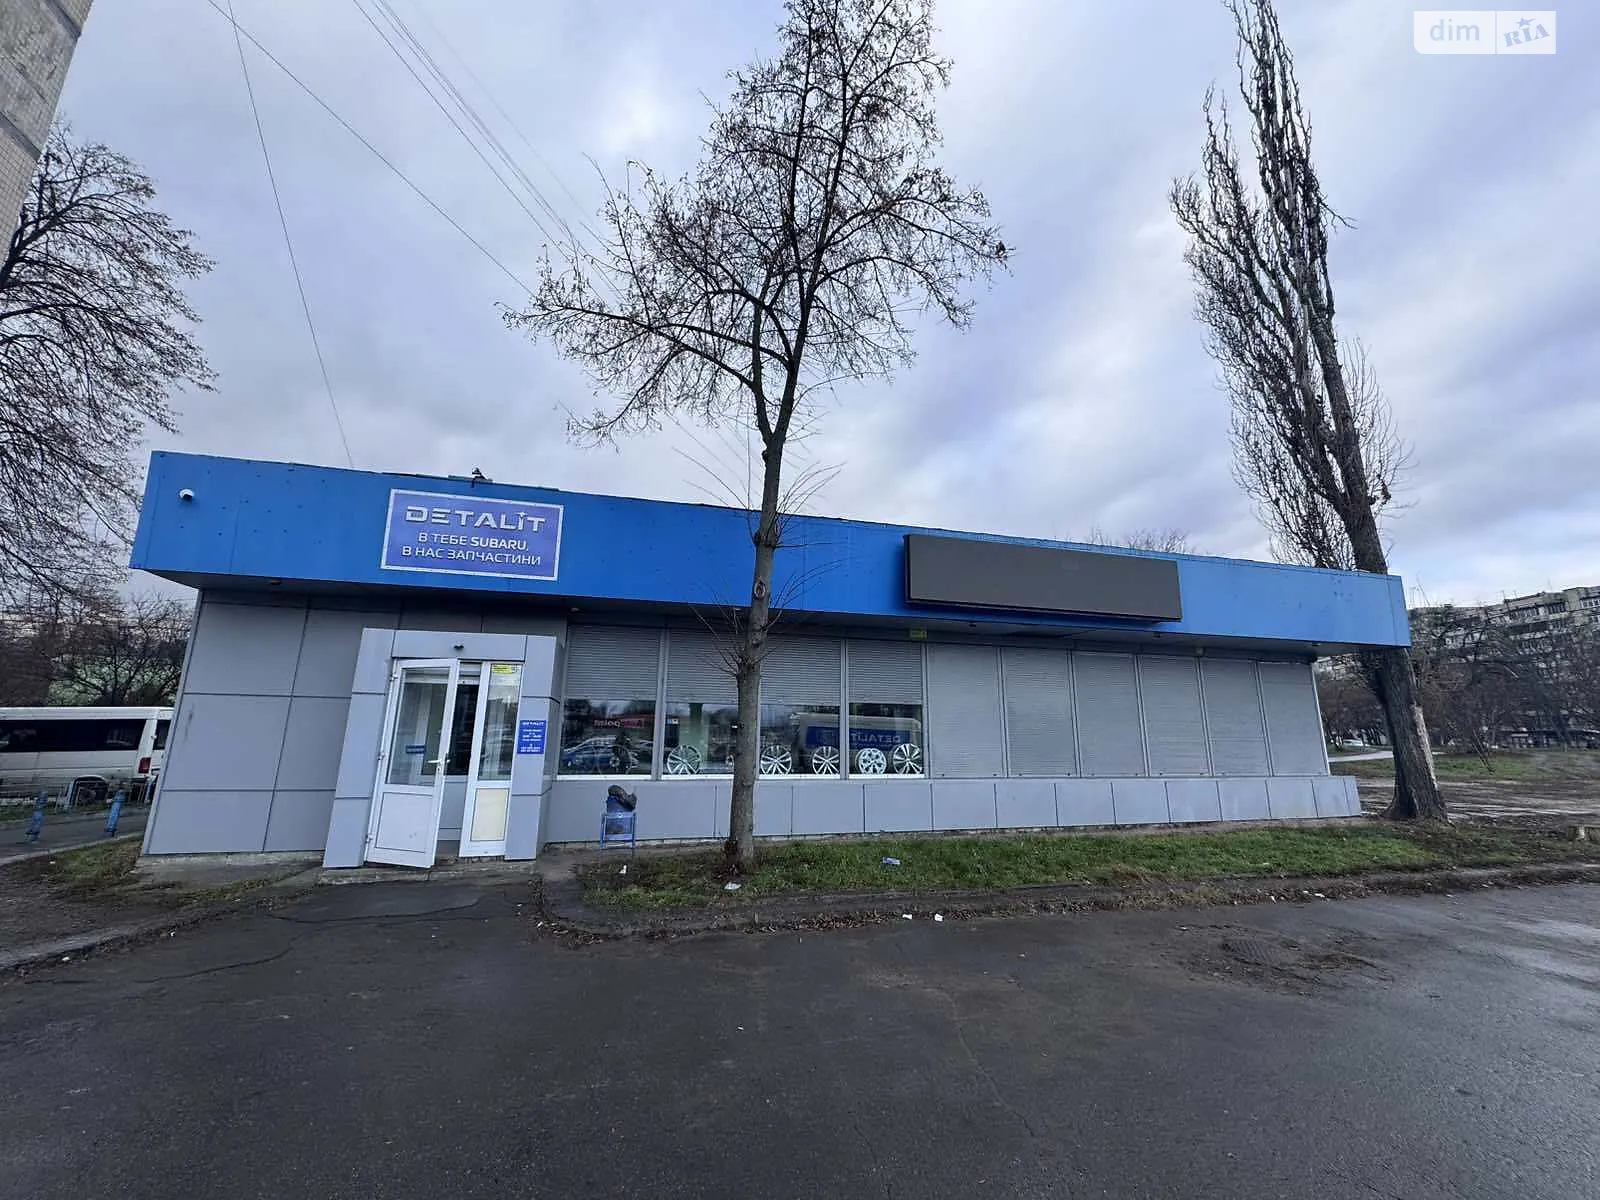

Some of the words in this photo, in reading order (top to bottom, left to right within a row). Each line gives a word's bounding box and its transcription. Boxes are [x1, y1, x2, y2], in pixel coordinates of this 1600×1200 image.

[405, 505, 546, 532] DETALIT
[418, 532, 428, 542] В
[431, 533, 468, 546] ТЕБЕ
[402, 545, 412, 556] В
[415, 547, 444, 559] НАС
[447, 549, 541, 565] ЗАПЧАСТИНИ
